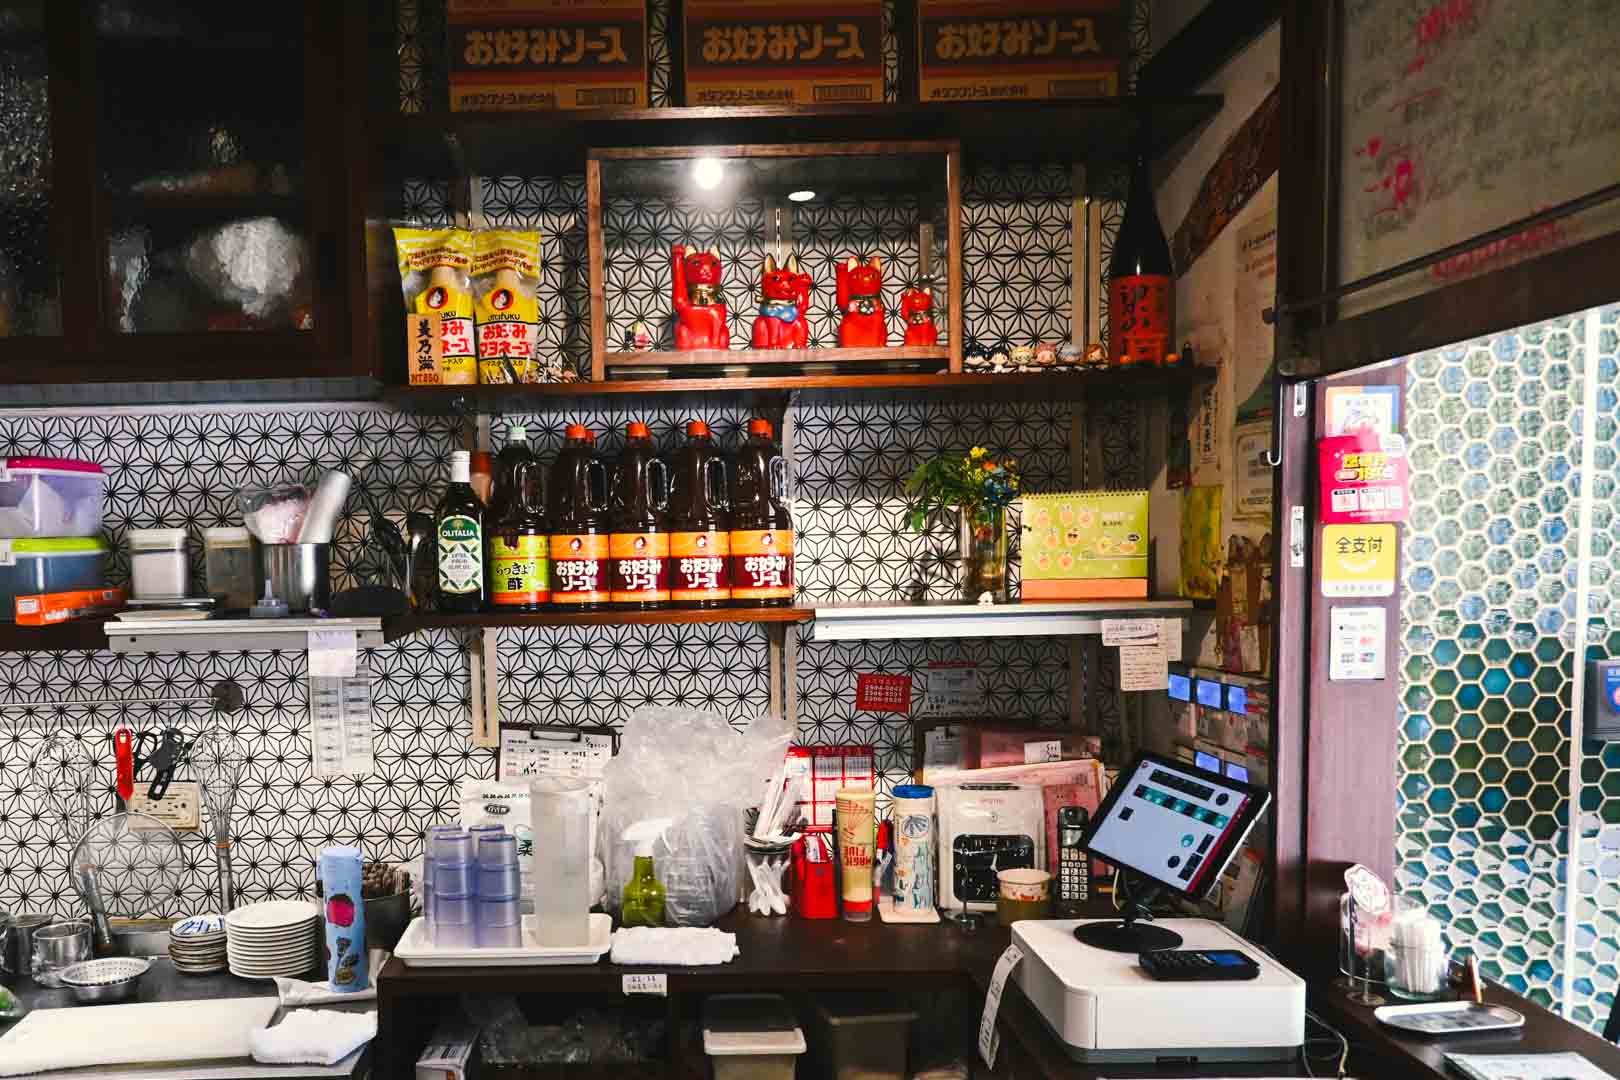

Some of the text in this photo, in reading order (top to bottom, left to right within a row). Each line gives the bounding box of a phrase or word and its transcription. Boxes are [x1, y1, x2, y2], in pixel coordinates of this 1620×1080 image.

[464, 27, 628, 65] お好みソース
[702, 22, 865, 63] お好みソース
[935, 17, 1100, 60] お好みソース
[483, 323, 527, 340] お好み
[416, 319, 434, 371] 美乃滋
[479, 341, 531, 357] マヨネーズ
[1335, 537, 1383, 554] 全支付
[496, 561, 536, 576] らっきょう
[556, 560, 599, 576] お好み
[619, 559, 662, 575] お好み
[680, 558, 723, 573] お好み
[744, 556, 787, 572] お好み
[507, 577, 523, 590] 酢
[561, 576, 597, 591] ソース
[625, 575, 657, 590] ソース
[686, 573, 719, 588] ソース
[751, 571, 783, 586] ソース
